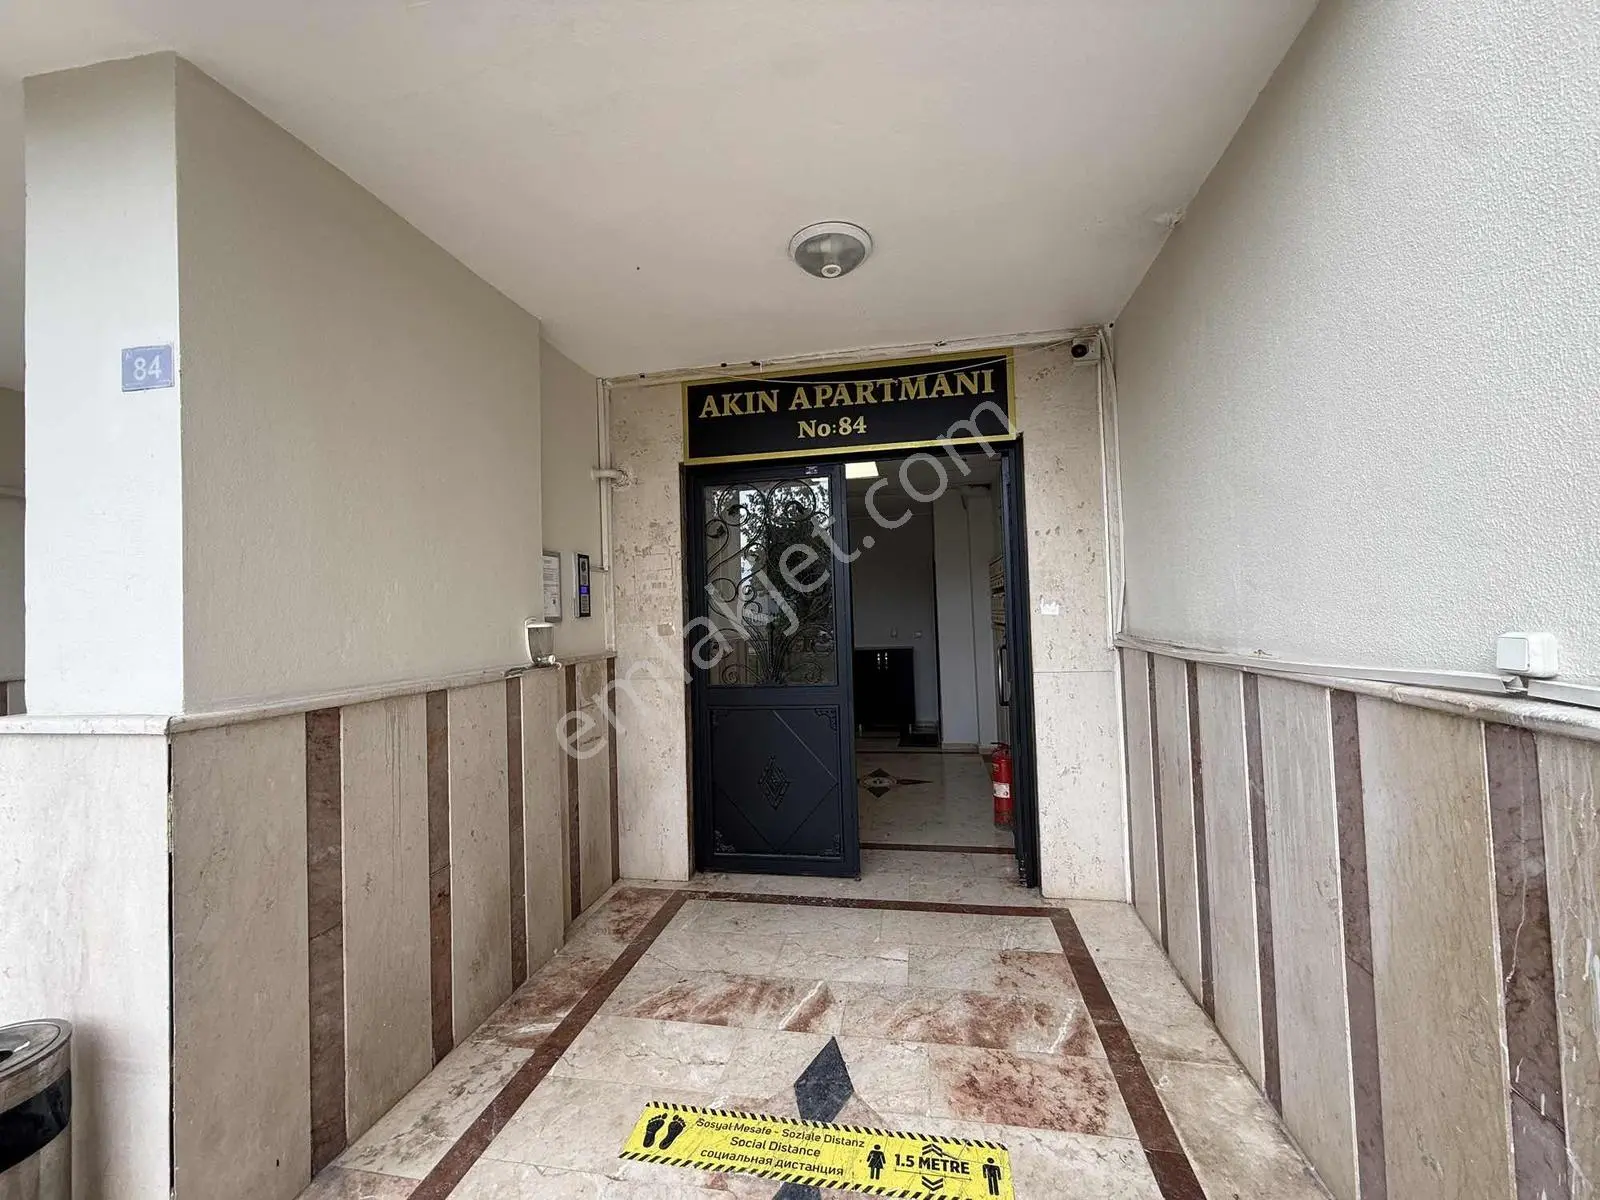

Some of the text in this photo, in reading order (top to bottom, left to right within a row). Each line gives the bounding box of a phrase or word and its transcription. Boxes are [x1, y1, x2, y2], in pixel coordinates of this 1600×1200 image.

[133, 354, 162, 381] 84
[698, 369, 996, 419] AKIN APARTMANI
[797, 415, 868, 439] No:84
[696, 1117, 732, 1131] Sosyal
[732, 1121, 772, 1136] Mesafe
[781, 1128, 822, 1143] Soziale
[823, 1134, 865, 1148] Distanz
[730, 1136, 821, 1158] Social Distance
[700, 1149, 844, 1177] социальная дистанция
[894, 1153, 971, 1175] 1.5 METRE
